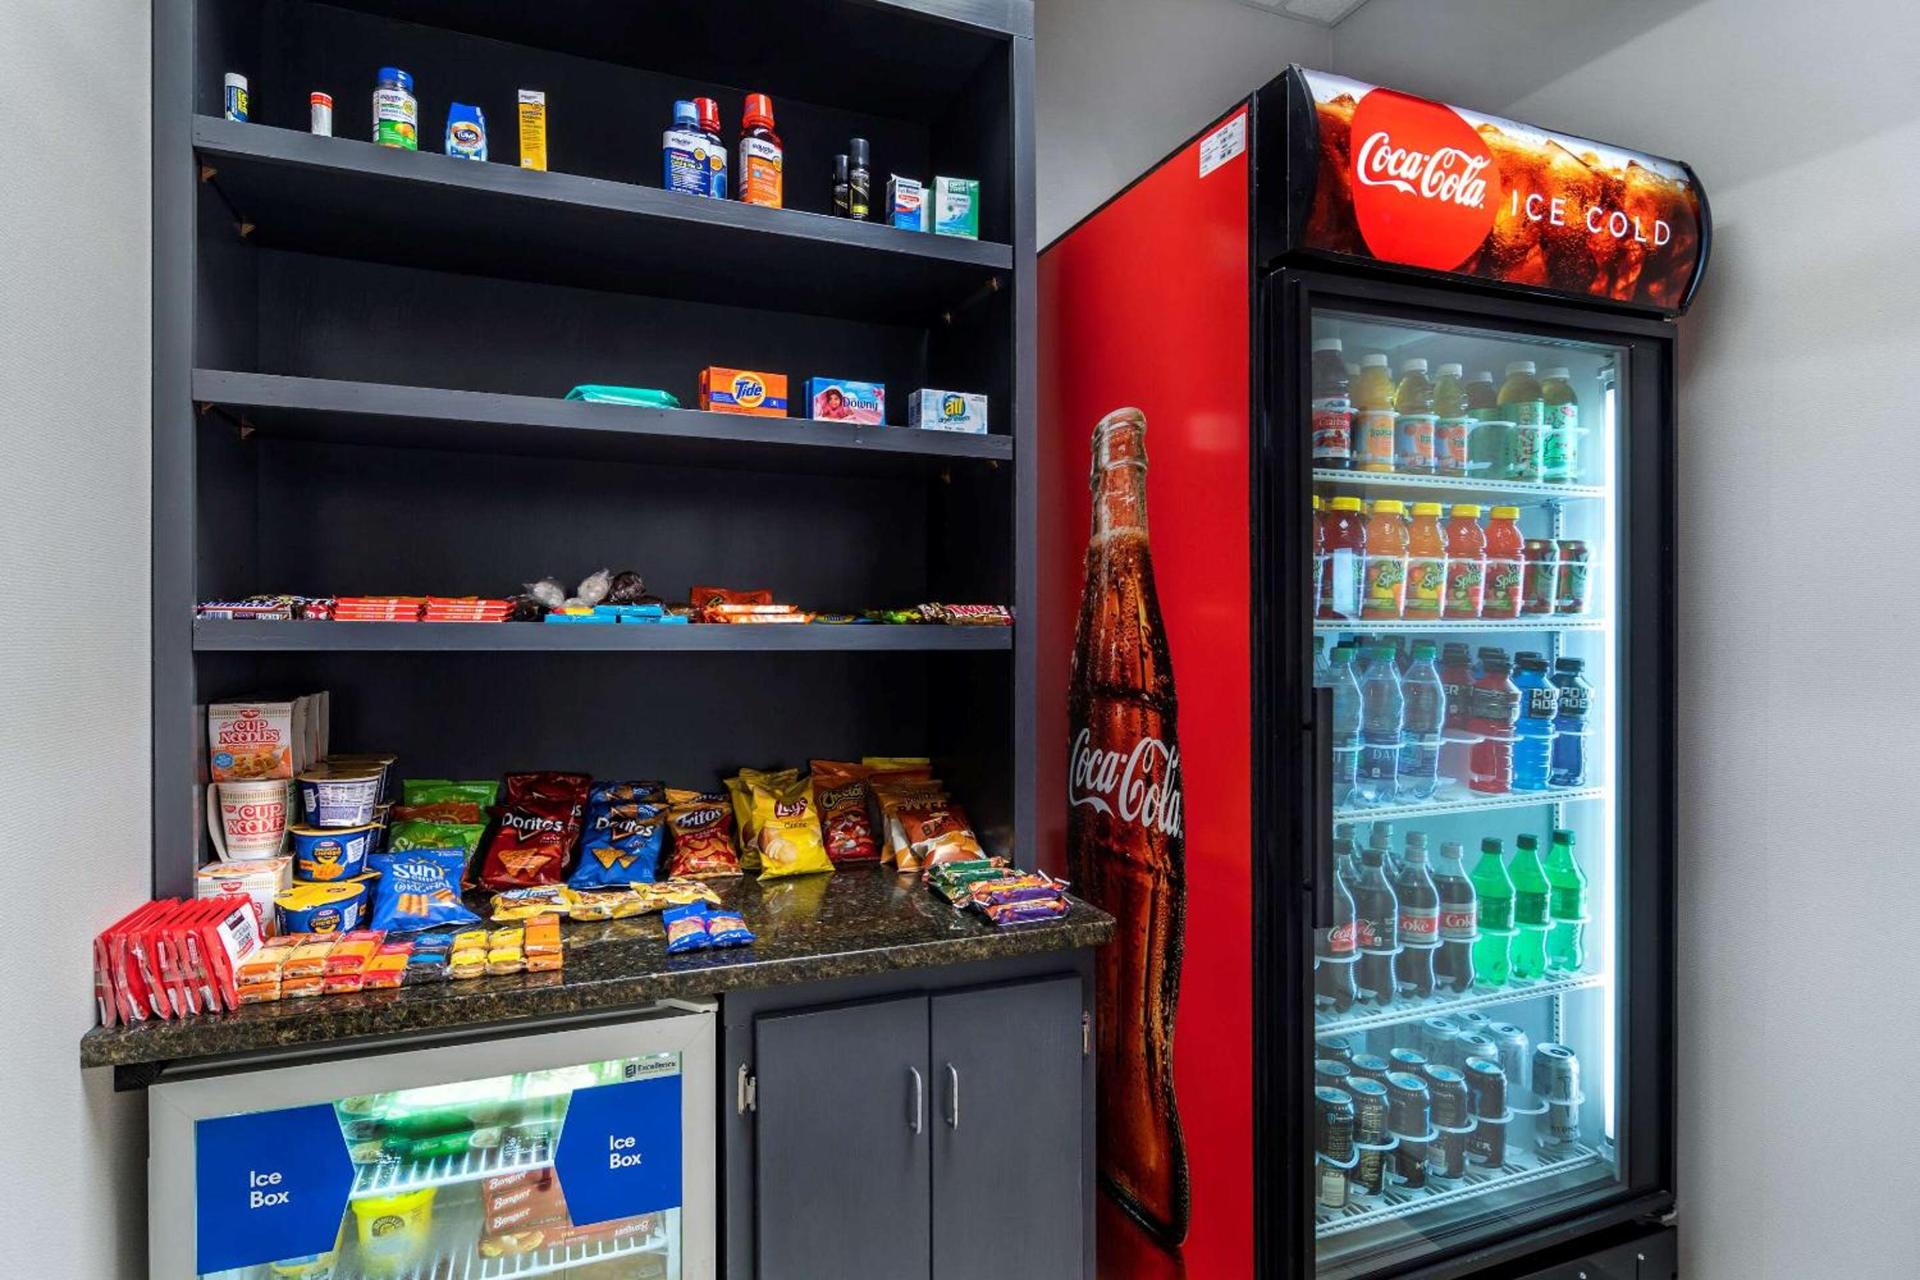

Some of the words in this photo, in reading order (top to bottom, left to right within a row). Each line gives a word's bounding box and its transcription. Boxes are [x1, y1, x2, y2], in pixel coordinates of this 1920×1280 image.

[1357, 131, 1490, 209] Coca-Cola
[1511, 190, 1565, 226] ICE
[1586, 205, 1671, 246] COLD
[735, 380, 763, 399] Tide
[842, 396, 878, 412] Downy
[945, 397, 964, 415] all
[1455, 572, 1481, 588] Splas
[1495, 573, 1520, 588] Splas
[1560, 686, 1590, 698] POW
[233, 719, 268, 732] CUP
[219, 729, 281, 744] NOODLES
[1069, 728, 1182, 838] Coca-Cola
[239, 803, 284, 820] CUP
[680, 808, 722, 827] Fritos
[227, 816, 285, 836] NOODLE
[502, 812, 564, 832] Doritos
[595, 816, 655, 837] Doritos
[392, 863, 437, 879] Sun
[610, 1135, 635, 1151] Ice
[610, 1152, 641, 1169] Box
[250, 1170, 282, 1188] Ice
[250, 1191, 289, 1209] Box
